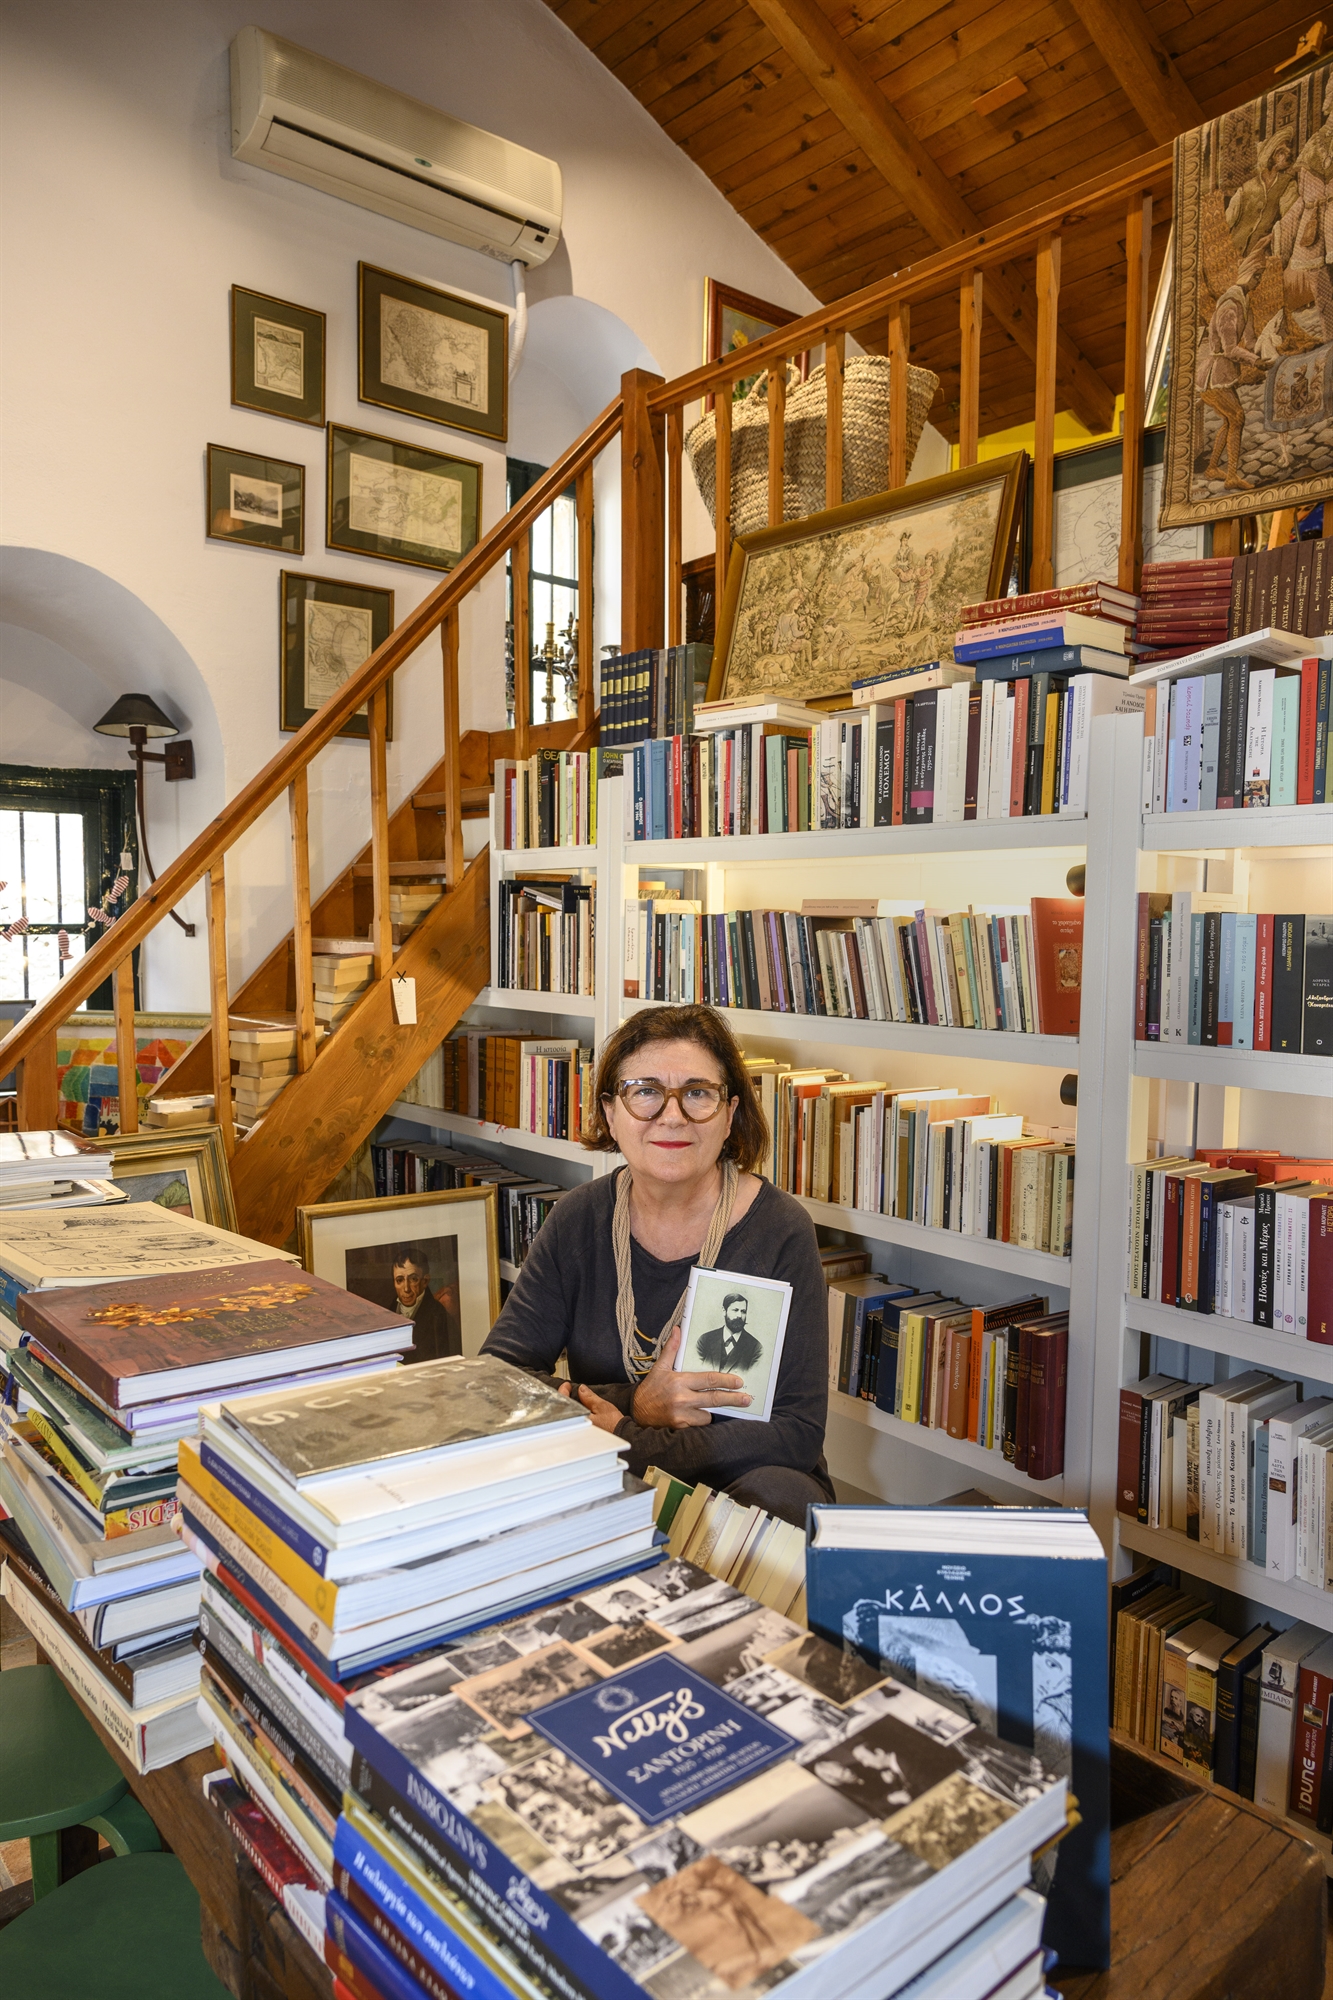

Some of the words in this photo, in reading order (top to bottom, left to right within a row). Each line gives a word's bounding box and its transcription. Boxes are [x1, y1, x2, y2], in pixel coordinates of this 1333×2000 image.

[1283, 588, 1291, 603] λόγοι
[603, 751, 618, 759] JOHN
[1259, 1222, 1270, 1251] Μέρες
[55, 1253, 264, 1274] ΜΟΝΕΜΒΑΣΙΑ
[1258, 1269, 1269, 1303] Ηδονές
[953, 1361, 961, 1390] Ομηρικοί
[1229, 1440, 1237, 1471] Καλοκαίρι
[129, 1500, 183, 1530] EDIS
[884, 1584, 1026, 1618] ΚΆΛΛΟΣ
[592, 1688, 705, 1758] Nelly's
[626, 1719, 743, 1784] ΣΑΝΤΟΡΙΝΗ
[1300, 1756, 1316, 1805] DUNE
[406, 1772, 487, 1869] SANTORINI
